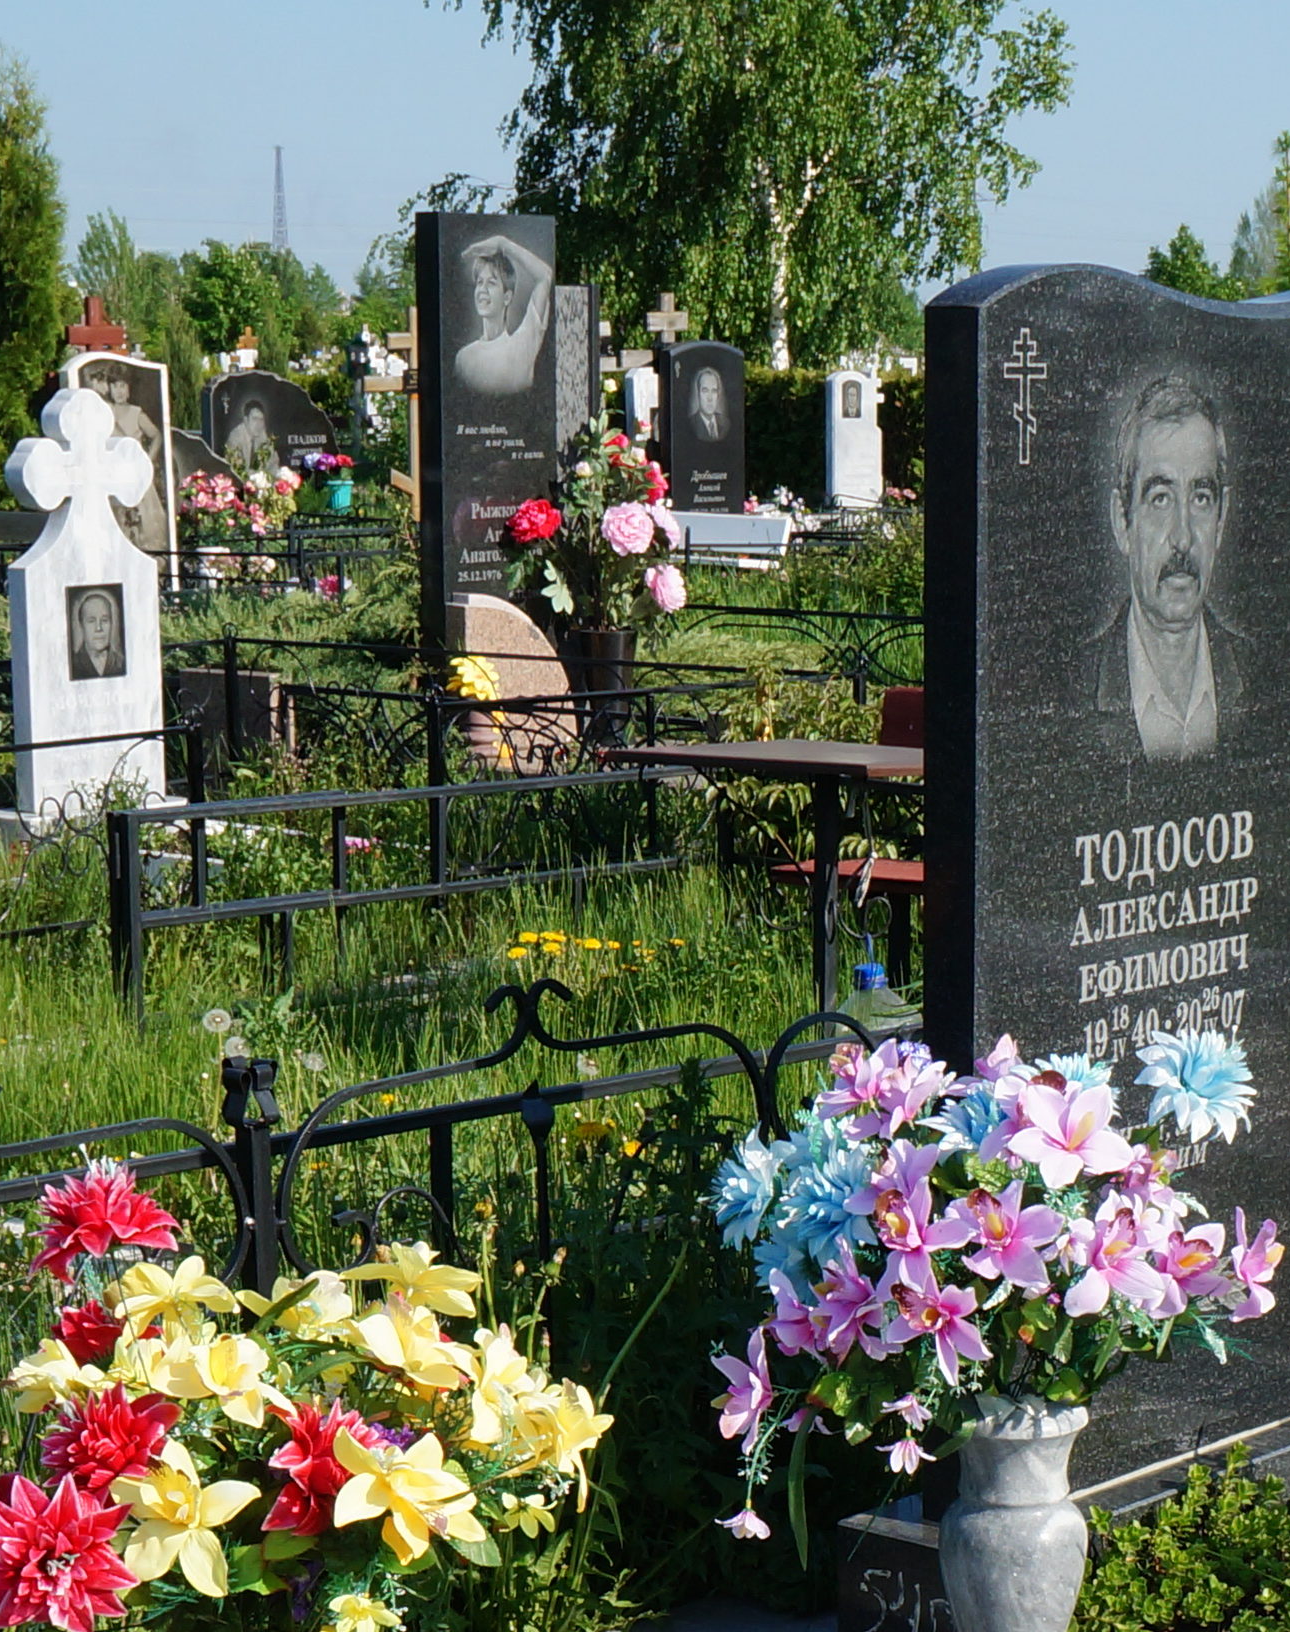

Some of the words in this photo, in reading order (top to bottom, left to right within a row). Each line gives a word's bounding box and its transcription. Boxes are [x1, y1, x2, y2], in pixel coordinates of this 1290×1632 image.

[471, 502, 519, 520] Рыжко
[1075, 810, 1254, 890] ТОДОСОВ
[1069, 877, 1259, 947] АЛЕКСАНДР
[1078, 933, 1250, 1003] ЕФИМОВИЧ
